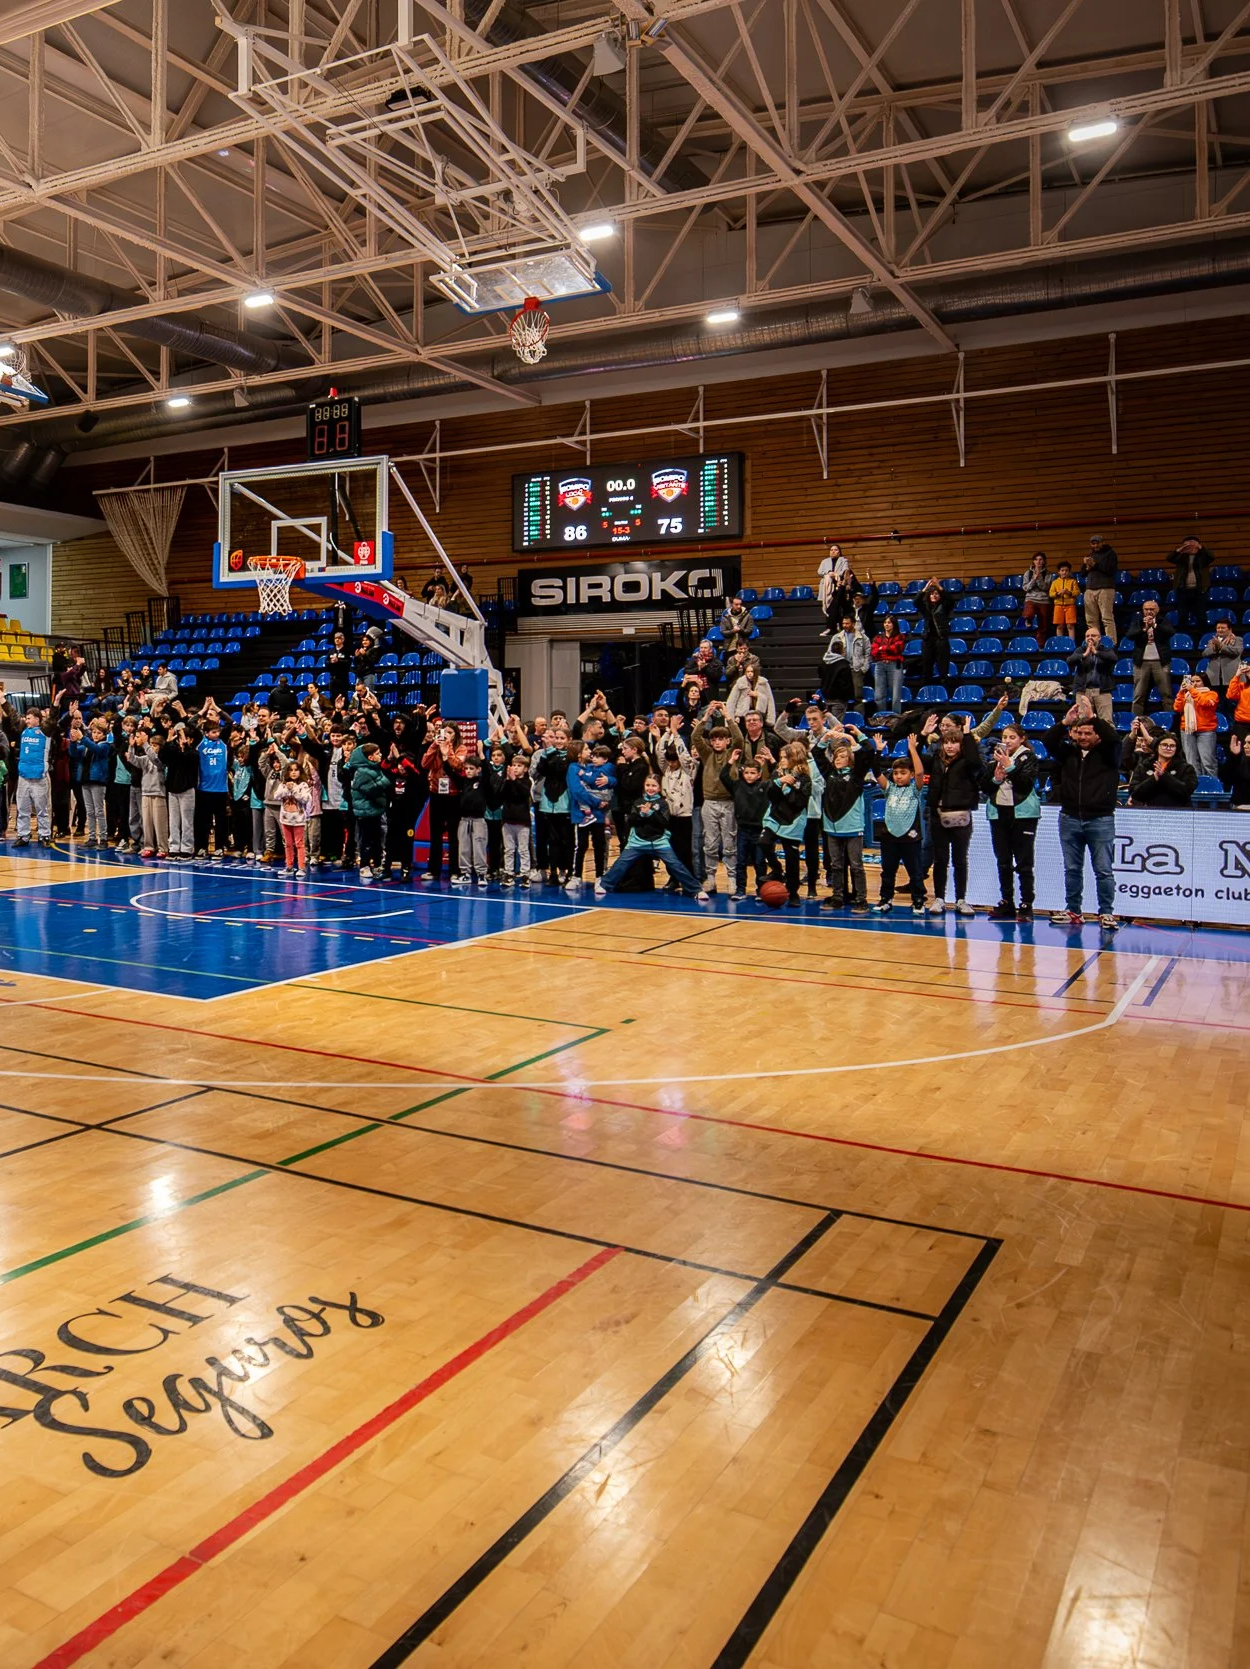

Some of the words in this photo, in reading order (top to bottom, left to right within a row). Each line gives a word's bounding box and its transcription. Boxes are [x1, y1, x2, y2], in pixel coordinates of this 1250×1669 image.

[606, 478, 636, 492] 00.0
[563, 524, 588, 541] 86
[657, 517, 683, 535] 75
[531, 568, 724, 606] SIROKO
[1112, 836, 1184, 875] La
[1118, 884, 1205, 898] eggaeton
[33, 1290, 385, 1479] Seguros
